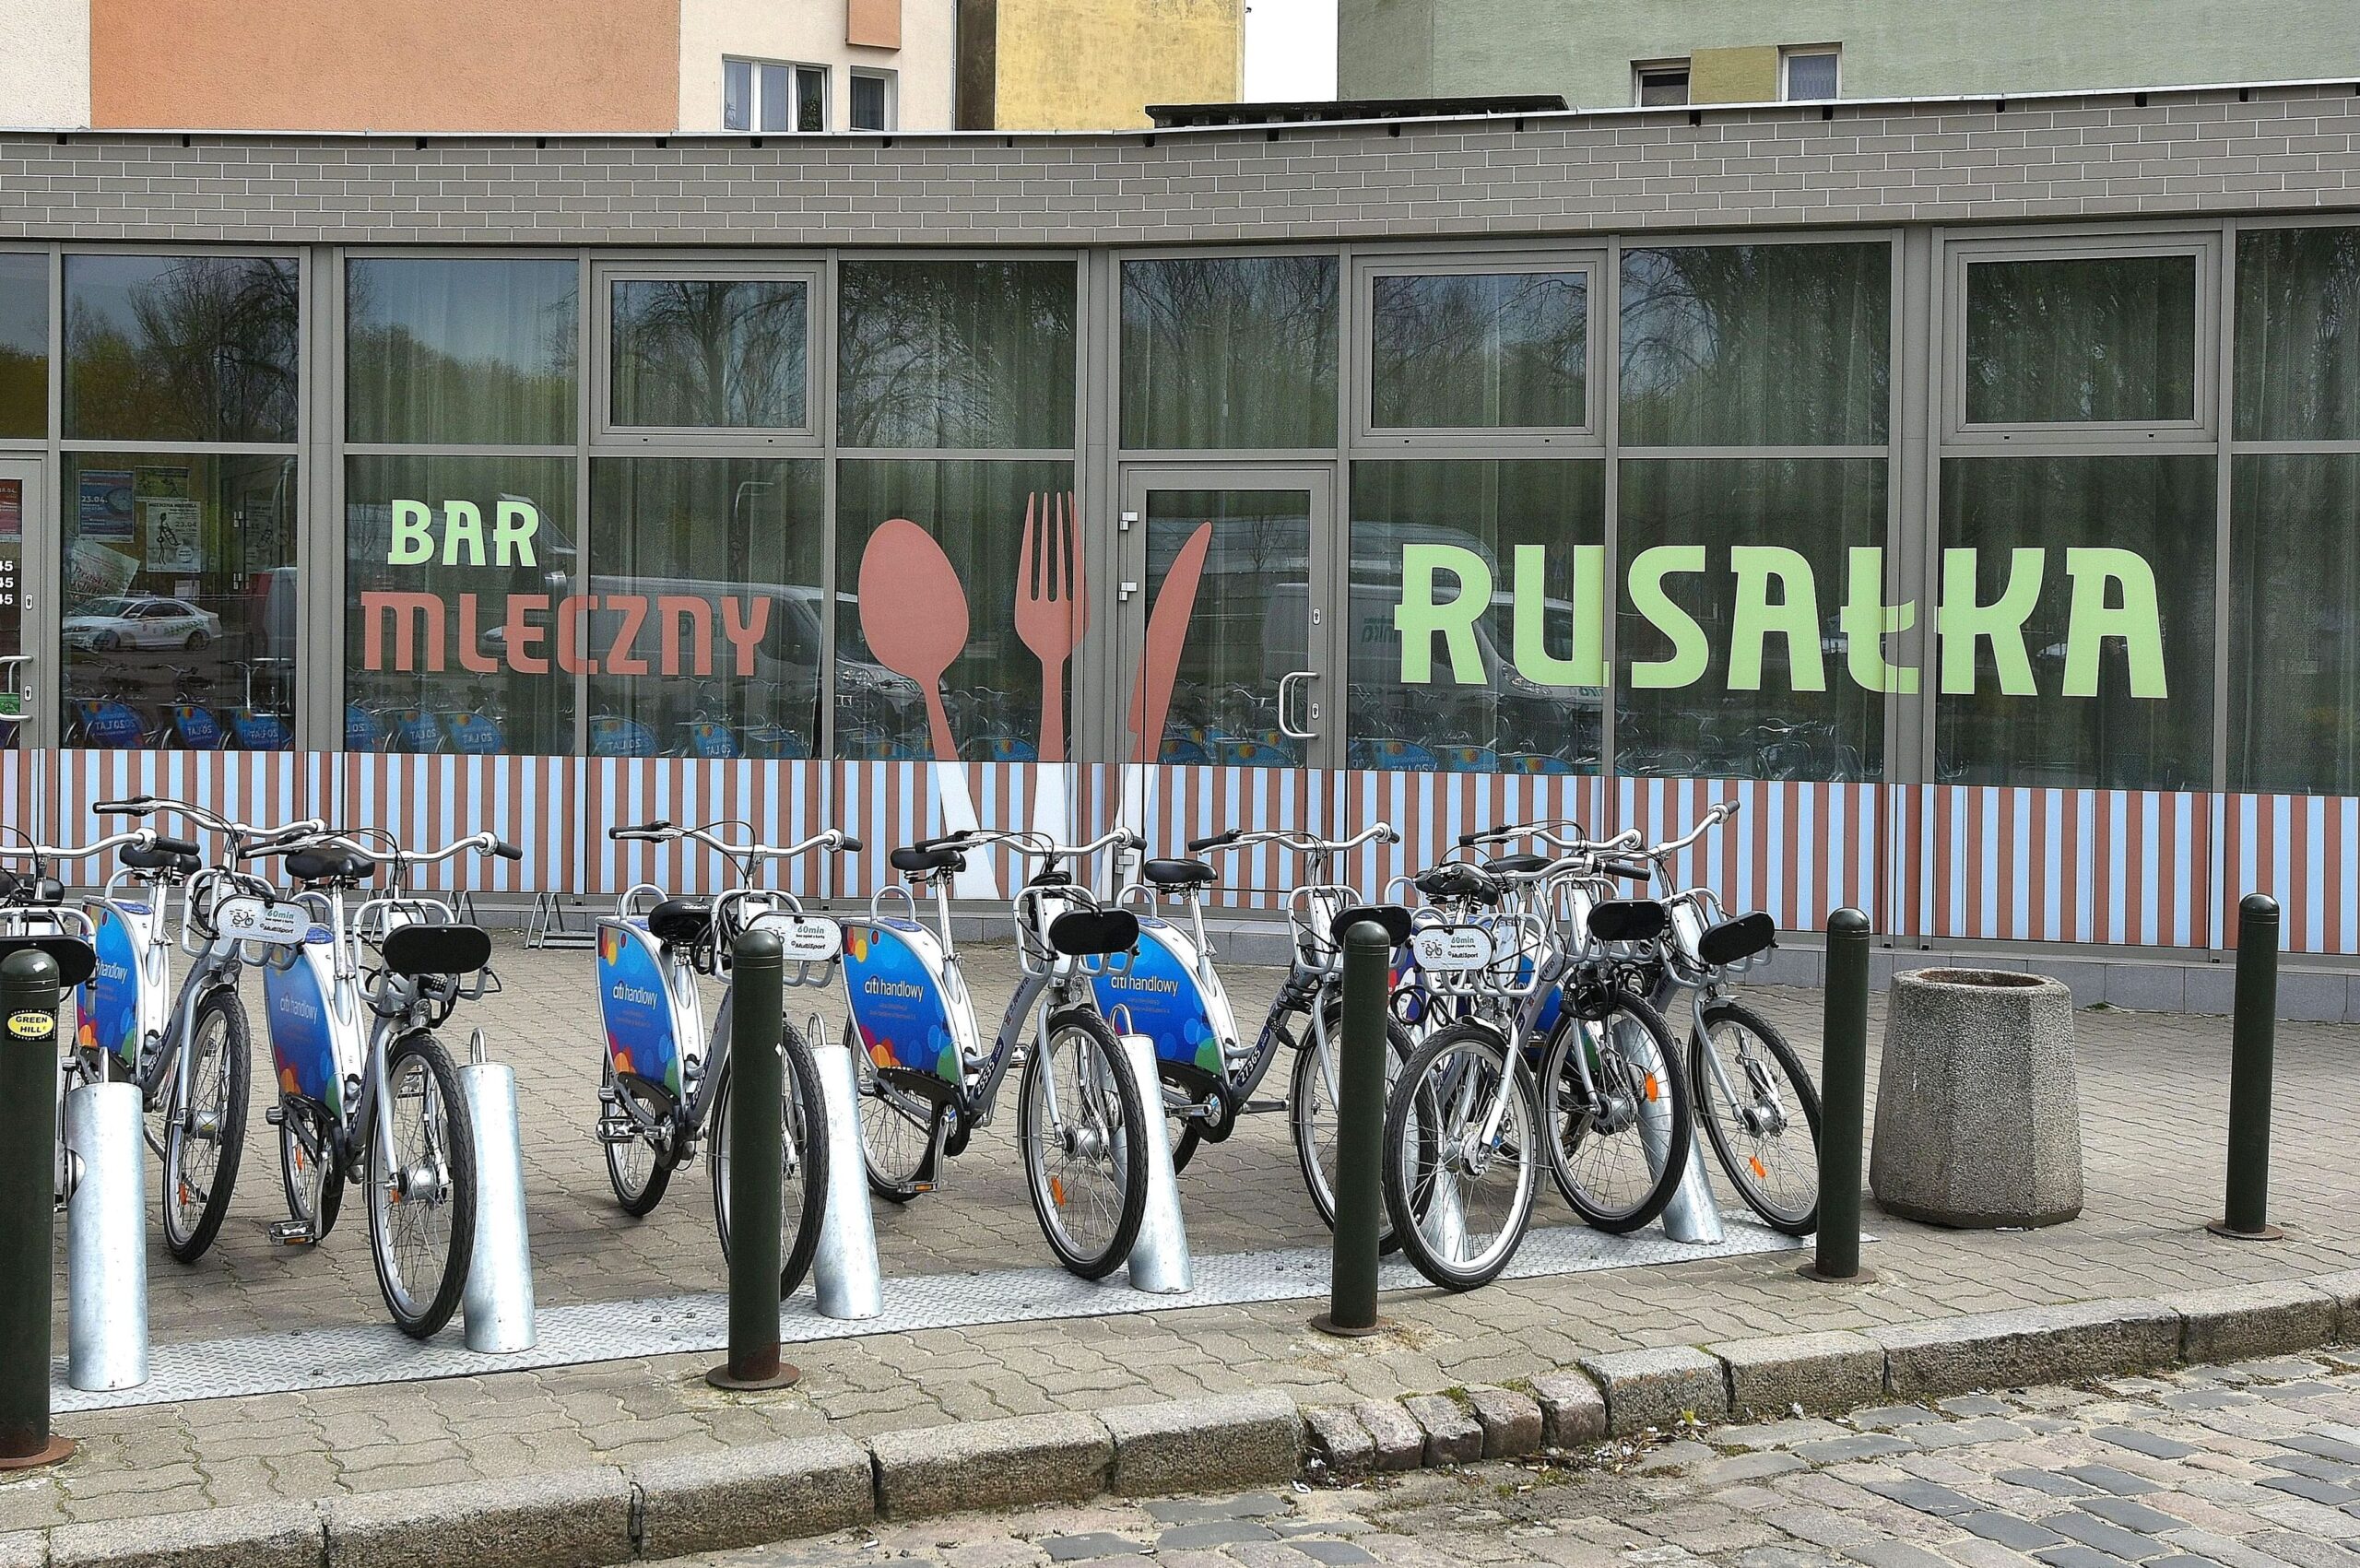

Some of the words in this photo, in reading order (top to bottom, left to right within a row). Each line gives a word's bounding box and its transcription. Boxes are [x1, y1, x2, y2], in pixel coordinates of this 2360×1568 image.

[81, 495, 108, 504] 23.04.
[387, 500, 539, 567] BAR
[360, 591, 771, 676] MLECZNY
[1394, 543, 2167, 699] RUSAŁKA
[266, 909, 295, 920] 60min
[796, 925, 825, 934] 60min
[1451, 936, 1475, 944] 60min
[624, 984, 658, 1010] handlowy
[865, 978, 879, 995] citi
[880, 979, 924, 1003] handlowy
[1111, 976, 1127, 989] citi
[1128, 974, 1179, 997] handlowy
[975, 1060, 996, 1096] 25535
[1239, 1048, 1261, 1084] 27365
